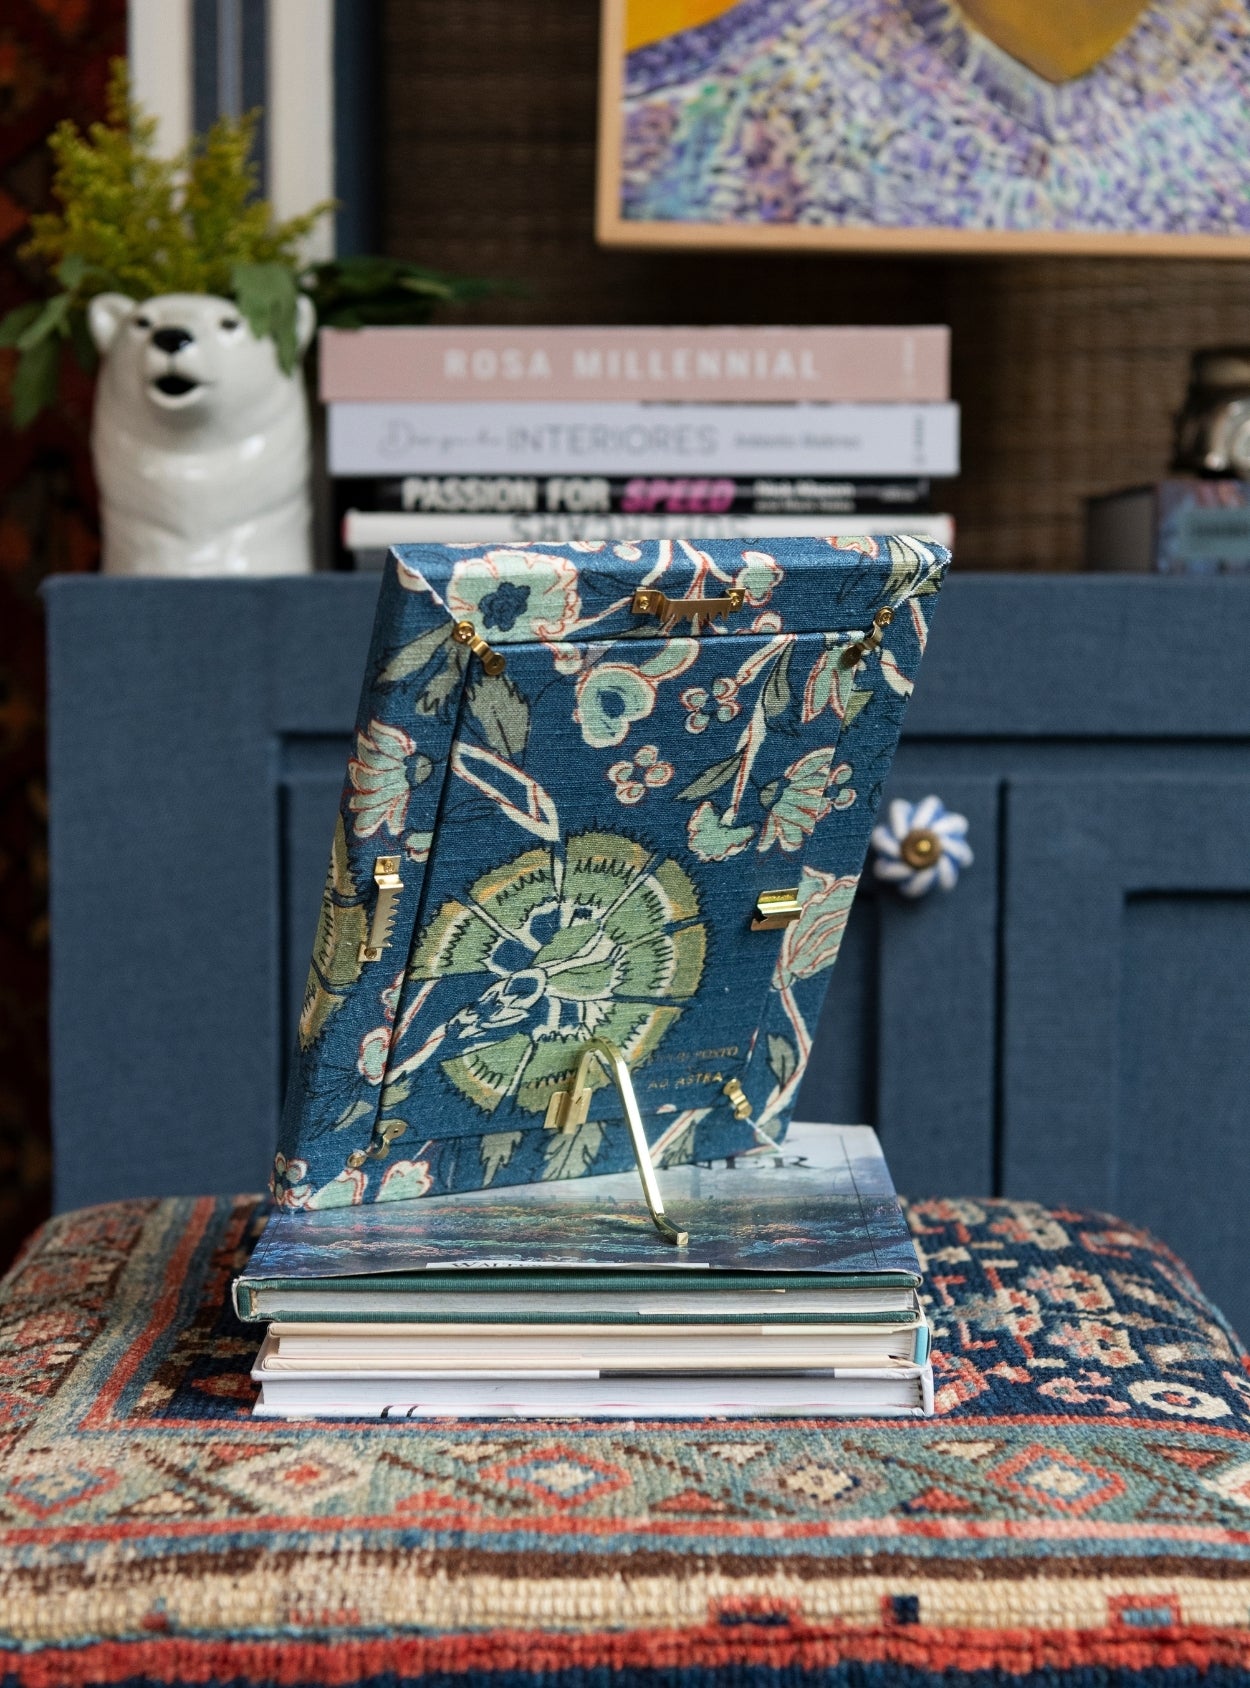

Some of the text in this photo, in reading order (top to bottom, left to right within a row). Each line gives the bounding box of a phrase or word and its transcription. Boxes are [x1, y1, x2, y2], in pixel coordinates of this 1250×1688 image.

[443, 348, 820, 381] ROSA MILLENNIAL
[506, 423, 718, 456] INTERIORES
[401, 478, 736, 512] PASSION FOR SPEED
